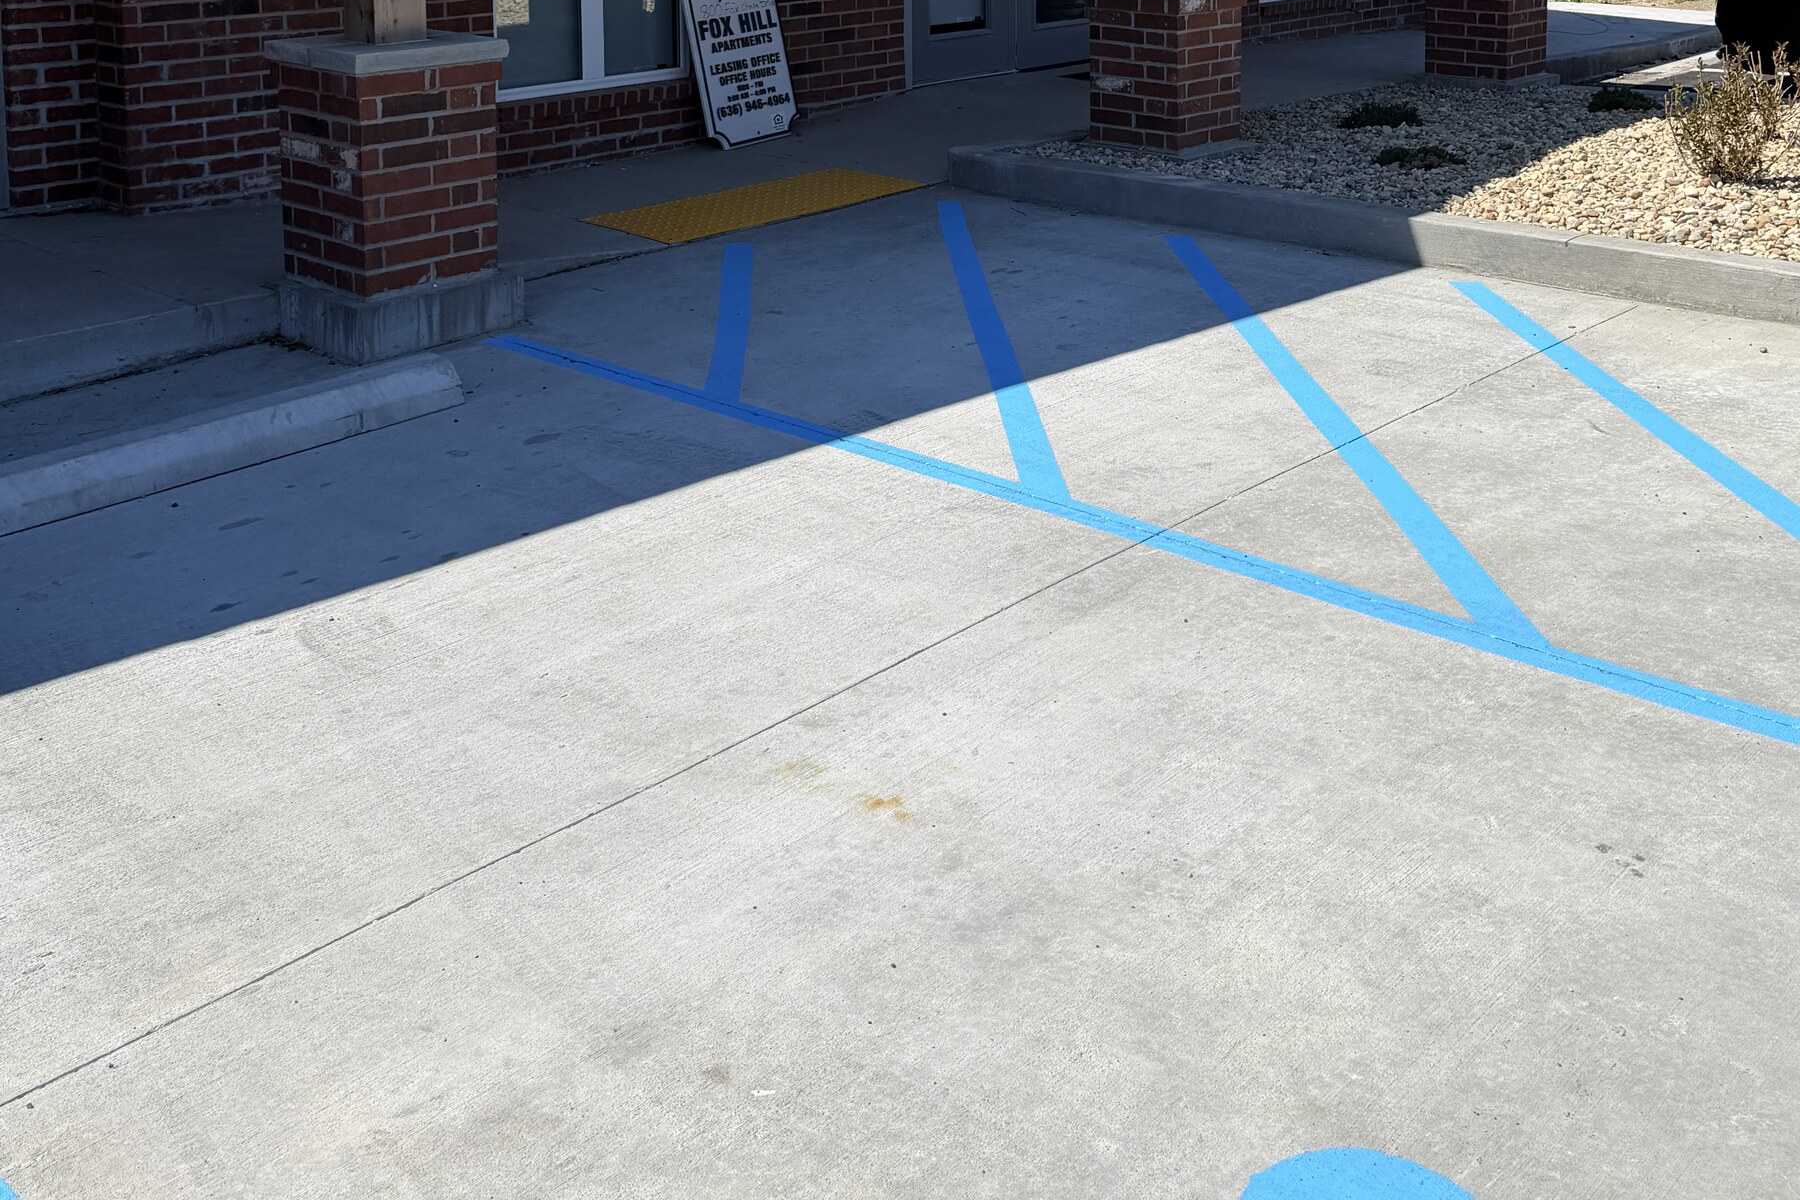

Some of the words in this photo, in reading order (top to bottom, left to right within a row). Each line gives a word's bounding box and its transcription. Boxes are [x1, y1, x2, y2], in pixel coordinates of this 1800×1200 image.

[698, 16, 734, 40] FOX
[738, 9, 777, 33] HILL
[712, 33, 772, 53] APARTMENTS
[710, 59, 748, 76] LEASING
[751, 52, 781, 67] OFFICE
[719, 71, 748, 86] OFFICE
[750, 66, 777, 80] HOURS
[717, 102, 742, 121] (636)
[744, 92, 790, 112] 946-4964
